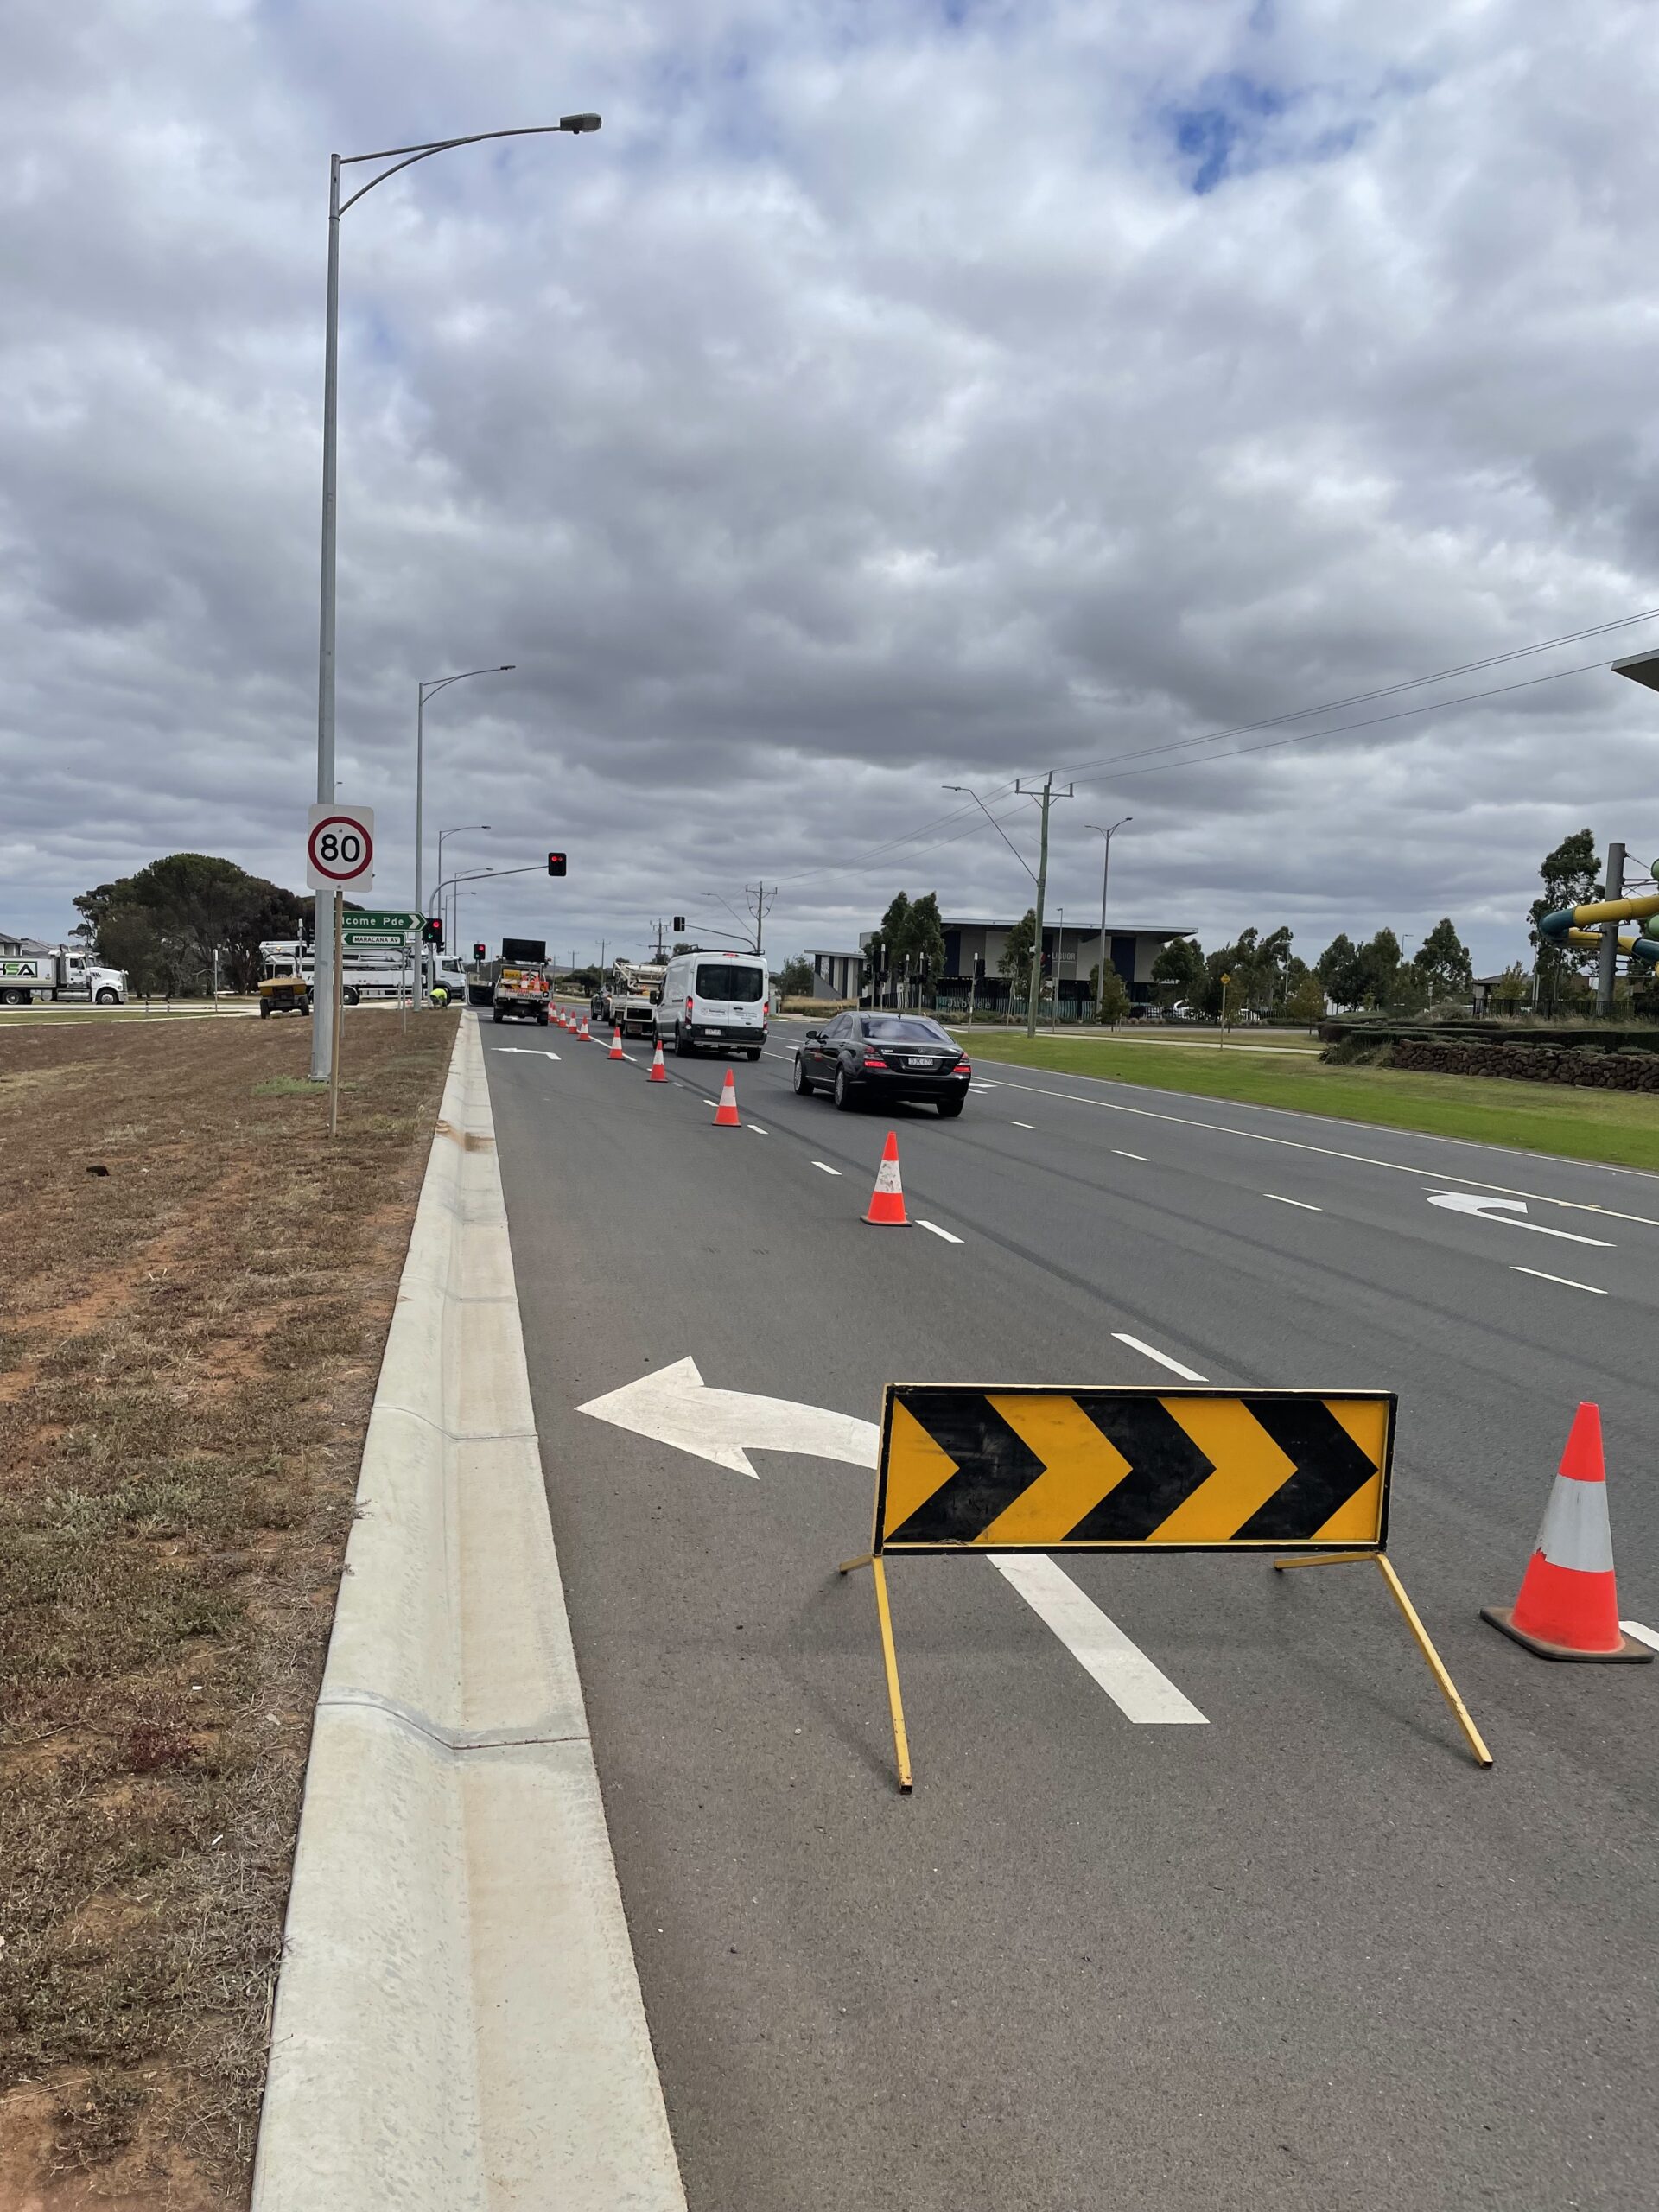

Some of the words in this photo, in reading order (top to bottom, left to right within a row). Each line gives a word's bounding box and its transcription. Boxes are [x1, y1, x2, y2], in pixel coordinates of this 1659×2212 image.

[321, 834, 360, 862] 80
[342, 917, 376, 925] lcome
[383, 917, 404, 925] Pde
[948, 998, 991, 1009] Jublee
